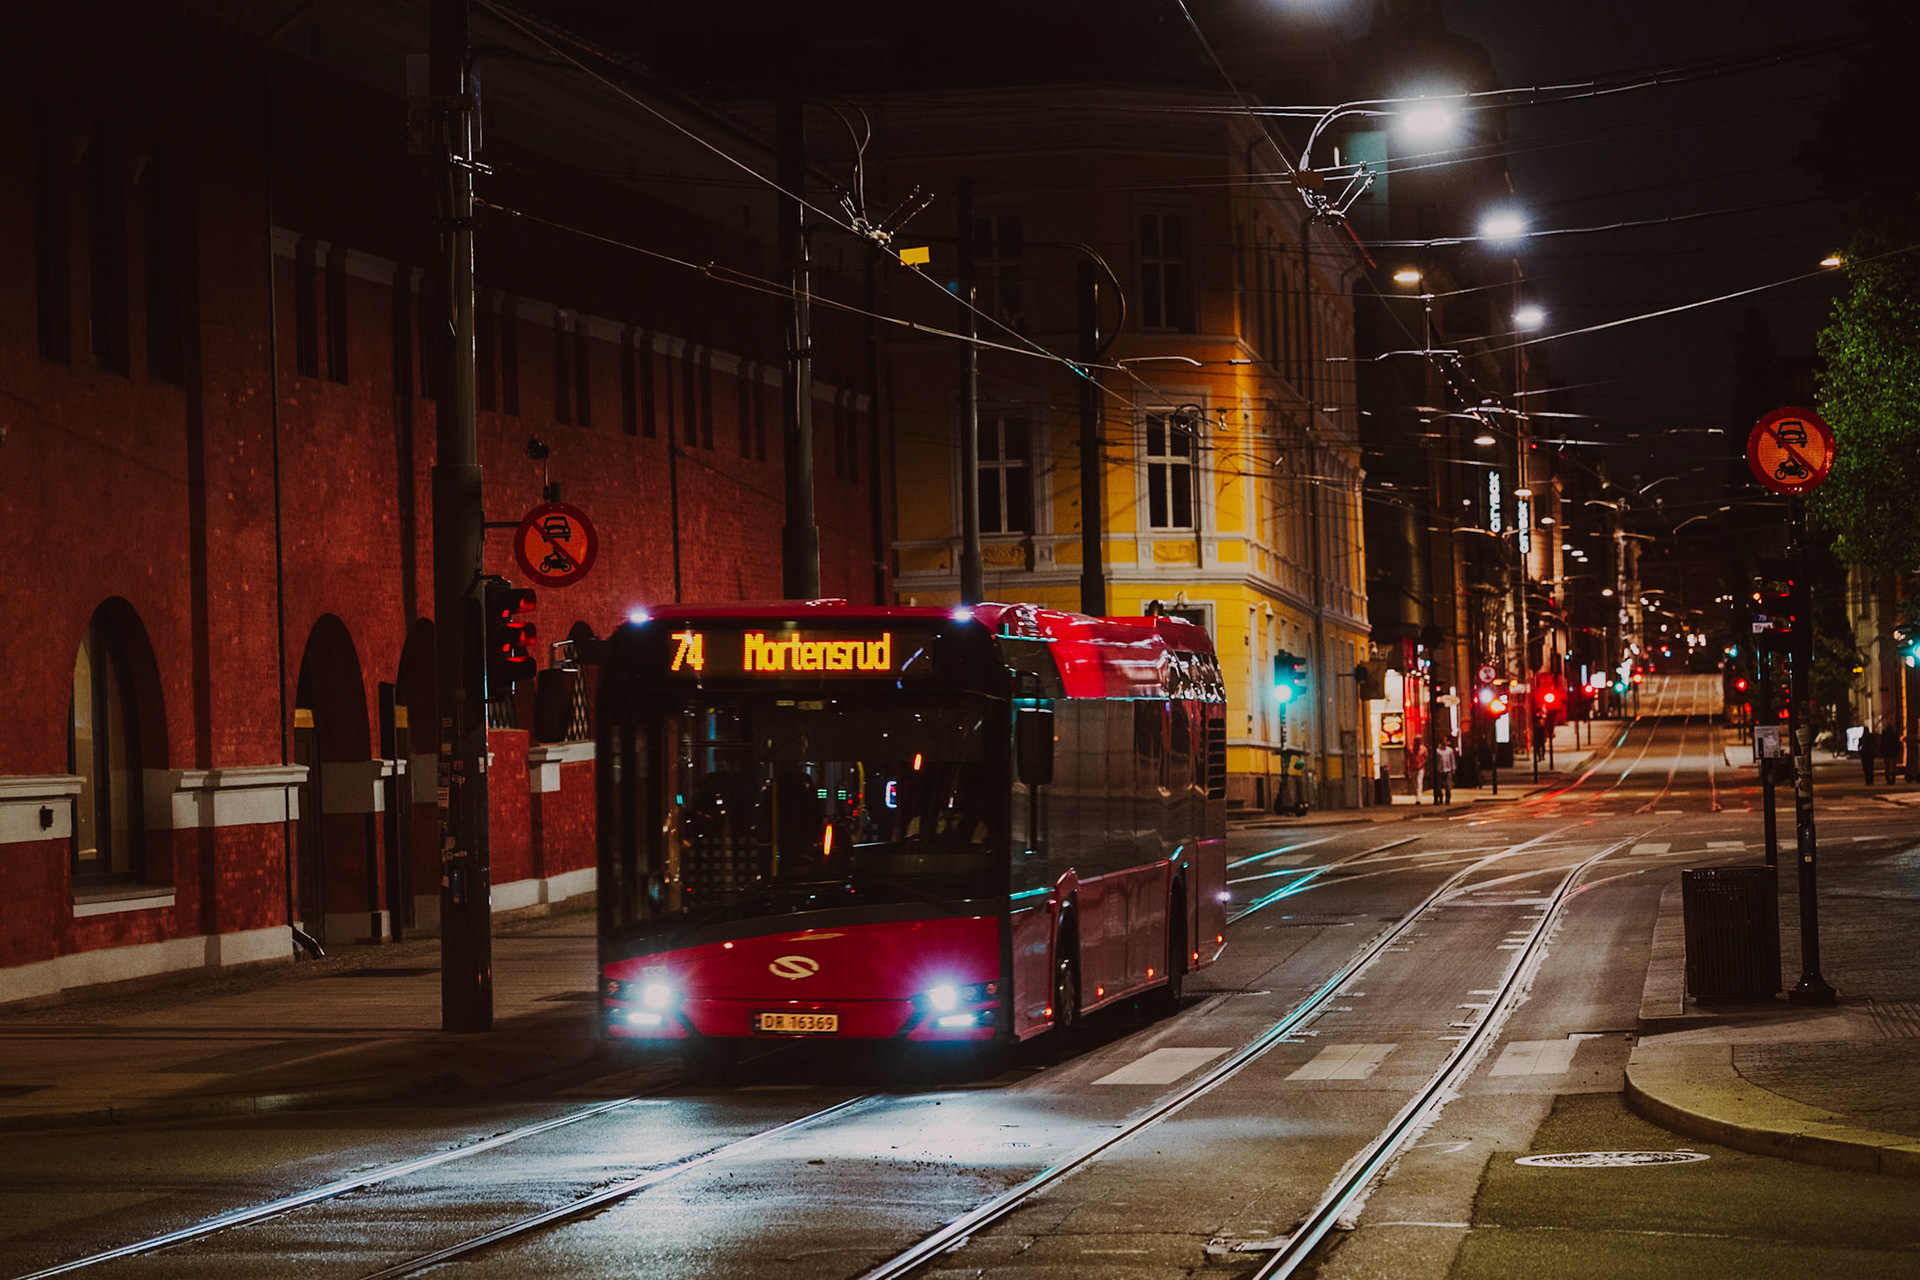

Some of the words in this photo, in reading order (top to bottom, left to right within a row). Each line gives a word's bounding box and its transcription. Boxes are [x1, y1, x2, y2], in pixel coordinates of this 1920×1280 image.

[1488, 470, 1501, 534] CITYBOX
[671, 633, 704, 671] 74
[743, 632, 891, 671] Mortensrud
[764, 1015, 785, 1029] DR
[788, 1016, 834, 1030] 16369
